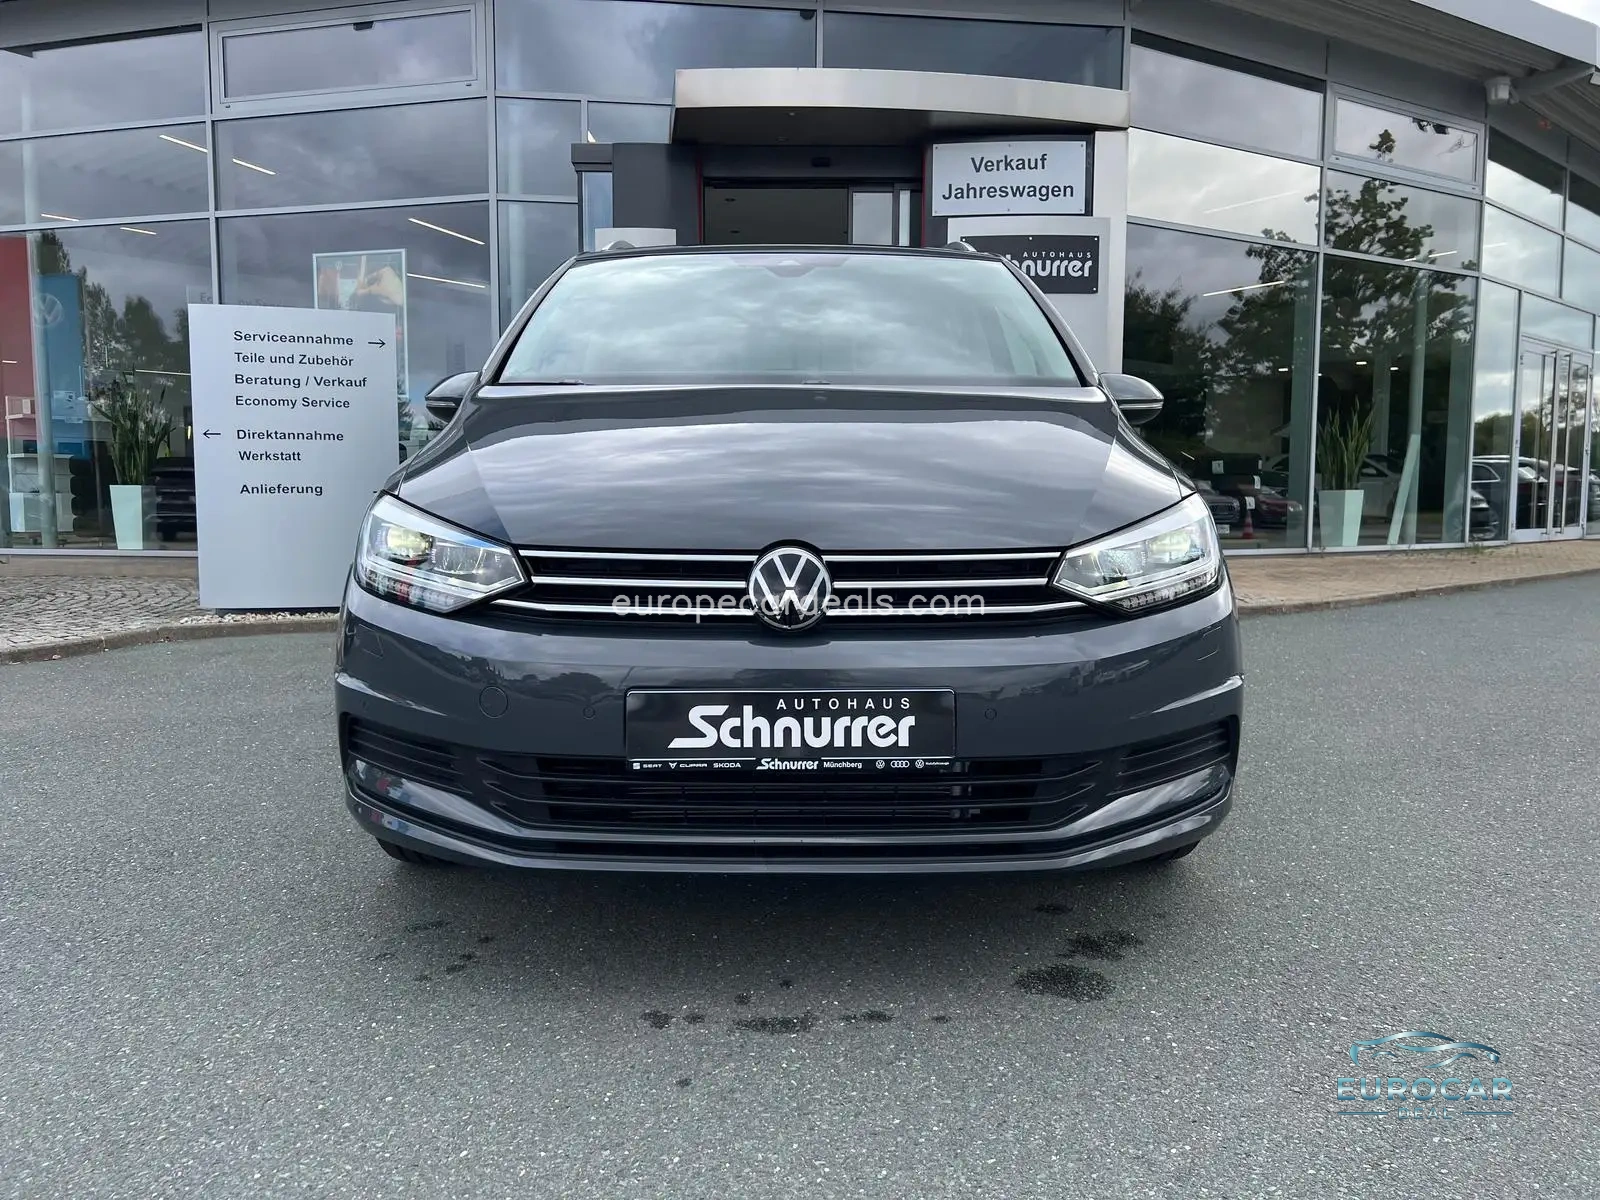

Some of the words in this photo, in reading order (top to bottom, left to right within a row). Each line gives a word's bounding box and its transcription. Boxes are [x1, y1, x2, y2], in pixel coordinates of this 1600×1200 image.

[971, 153, 1047, 173] Verkauf
[942, 182, 1074, 202] Jahreswagen
[1023, 251, 1092, 259] AUTOHAUS
[233, 330, 354, 346] Serviceannahme
[234, 352, 265, 364] Teile
[269, 353, 295, 365] und
[298, 354, 354, 367] Zubehör
[234, 374, 301, 389] Beratung
[314, 377, 368, 388] Verkauf
[235, 395, 297, 410] Economy
[302, 397, 350, 409] Service
[236, 429, 344, 442] Direktannahme
[238, 450, 302, 462] Werkstatt
[240, 483, 323, 497] Anlieferung
[776, 697, 911, 710] AUTOHAUS
[667, 704, 916, 749] Schnurrer
[755, 757, 819, 771] Schnurrer
[823, 760, 863, 770] Münchberg
